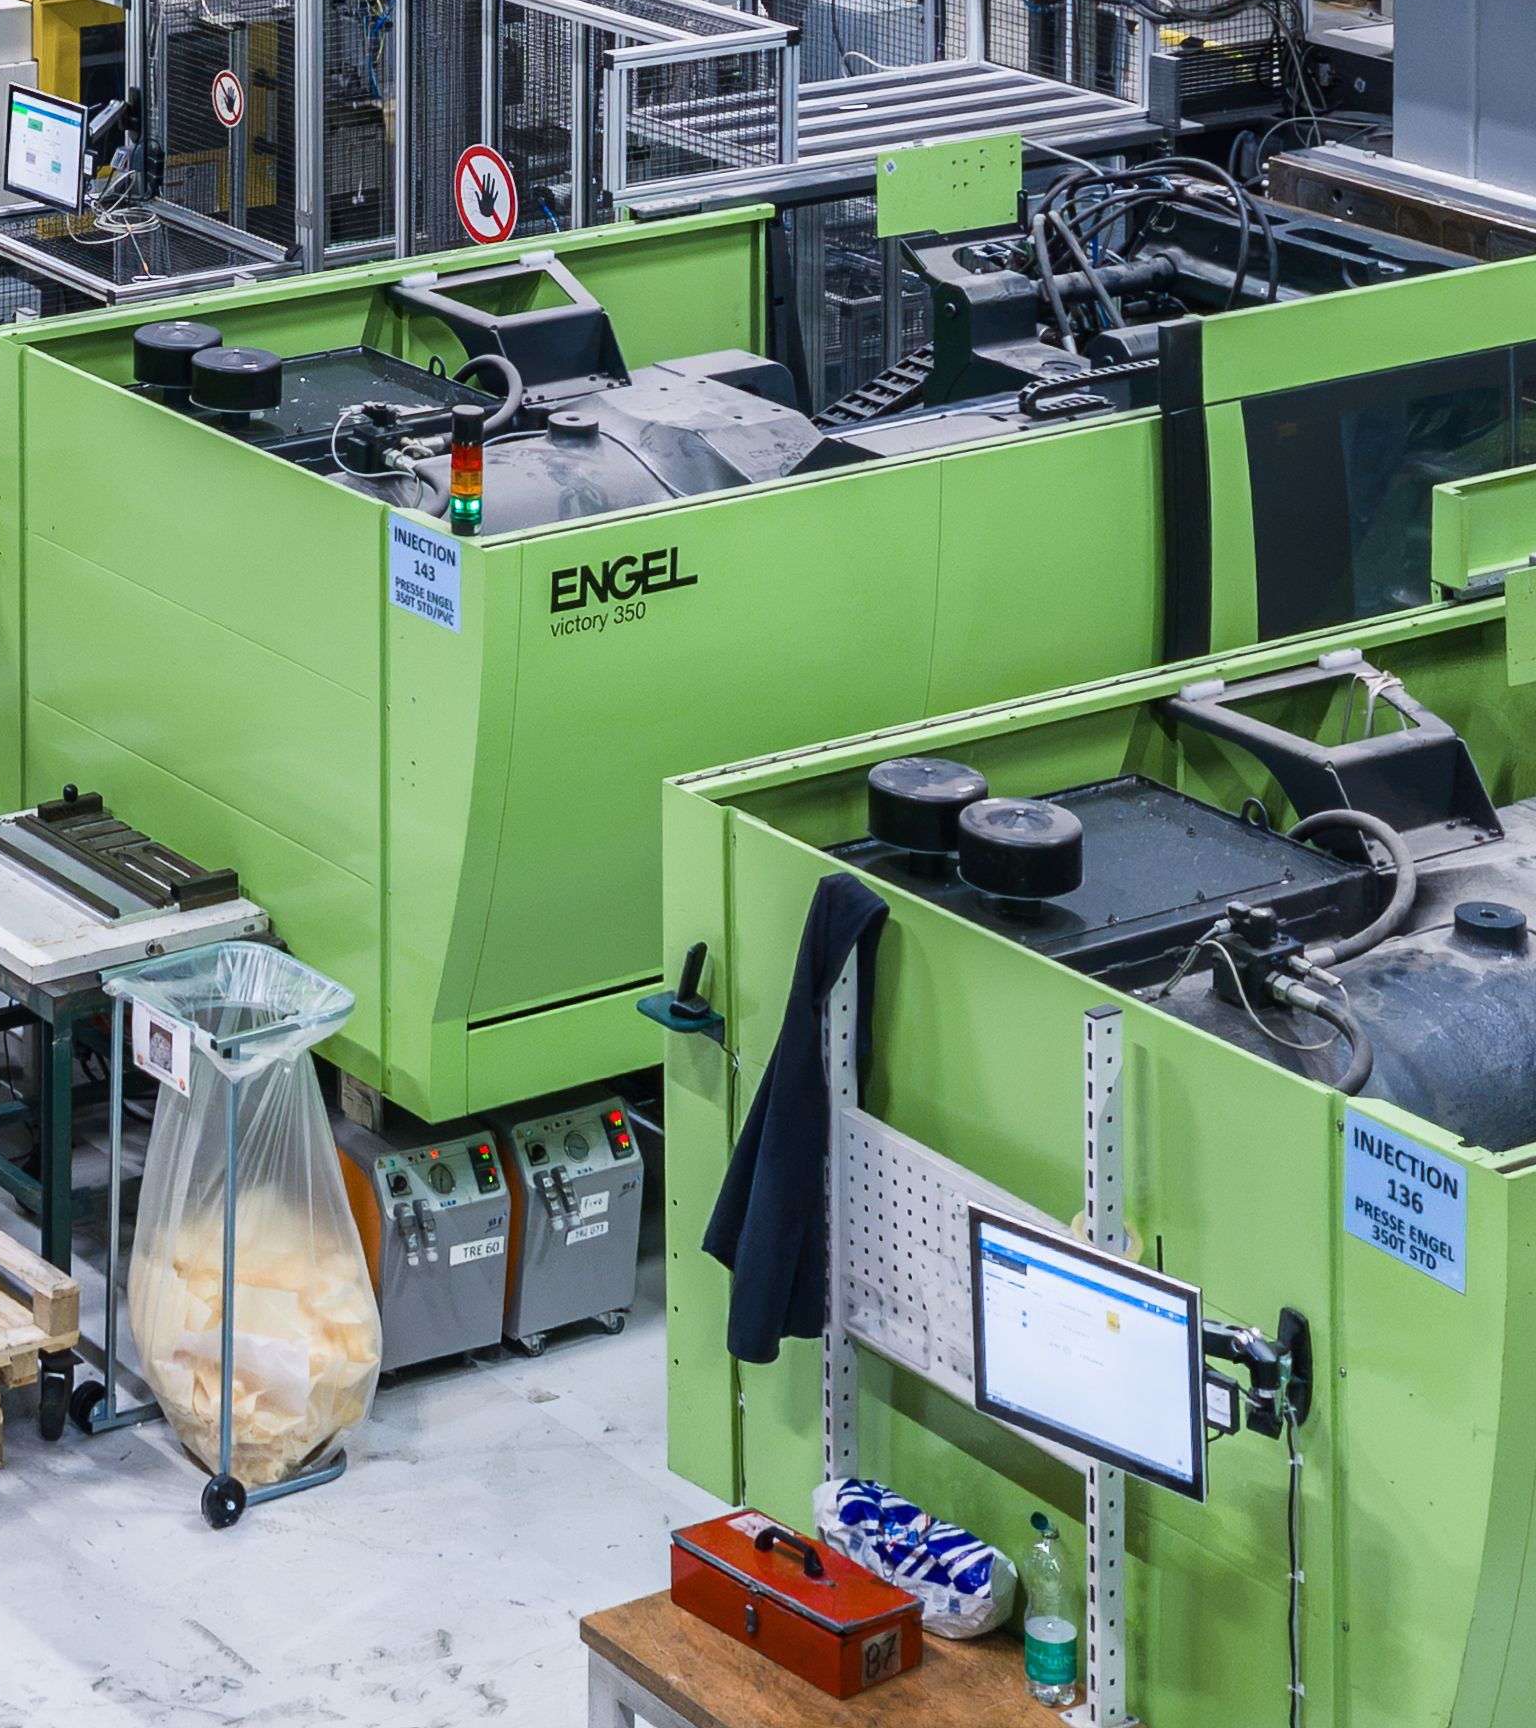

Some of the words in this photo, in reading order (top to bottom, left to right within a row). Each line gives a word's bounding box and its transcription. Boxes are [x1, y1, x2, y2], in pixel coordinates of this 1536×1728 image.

[394, 525, 456, 567] INJECTION
[413, 559, 436, 582] 143
[550, 547, 698, 614] ENGEL
[395, 576, 425, 600] PRESSE
[427, 589, 455, 613] ENGEL
[395, 589, 416, 608] 350T
[417, 599, 454, 627] STD/PVC
[550, 611, 609, 638] victory
[613, 602, 647, 625] 350
[1354, 1126, 1458, 1200] INJECTION
[1387, 1178, 1424, 1215] 136
[1355, 1195, 1405, 1236] PRESSE
[1409, 1223, 1456, 1263] ENGEL
[1371, 1223, 1407, 1254] 350T
[1409, 1243, 1437, 1271] STD
[462, 1244, 482, 1259] TRE
[485, 1241, 500, 1254] 60
